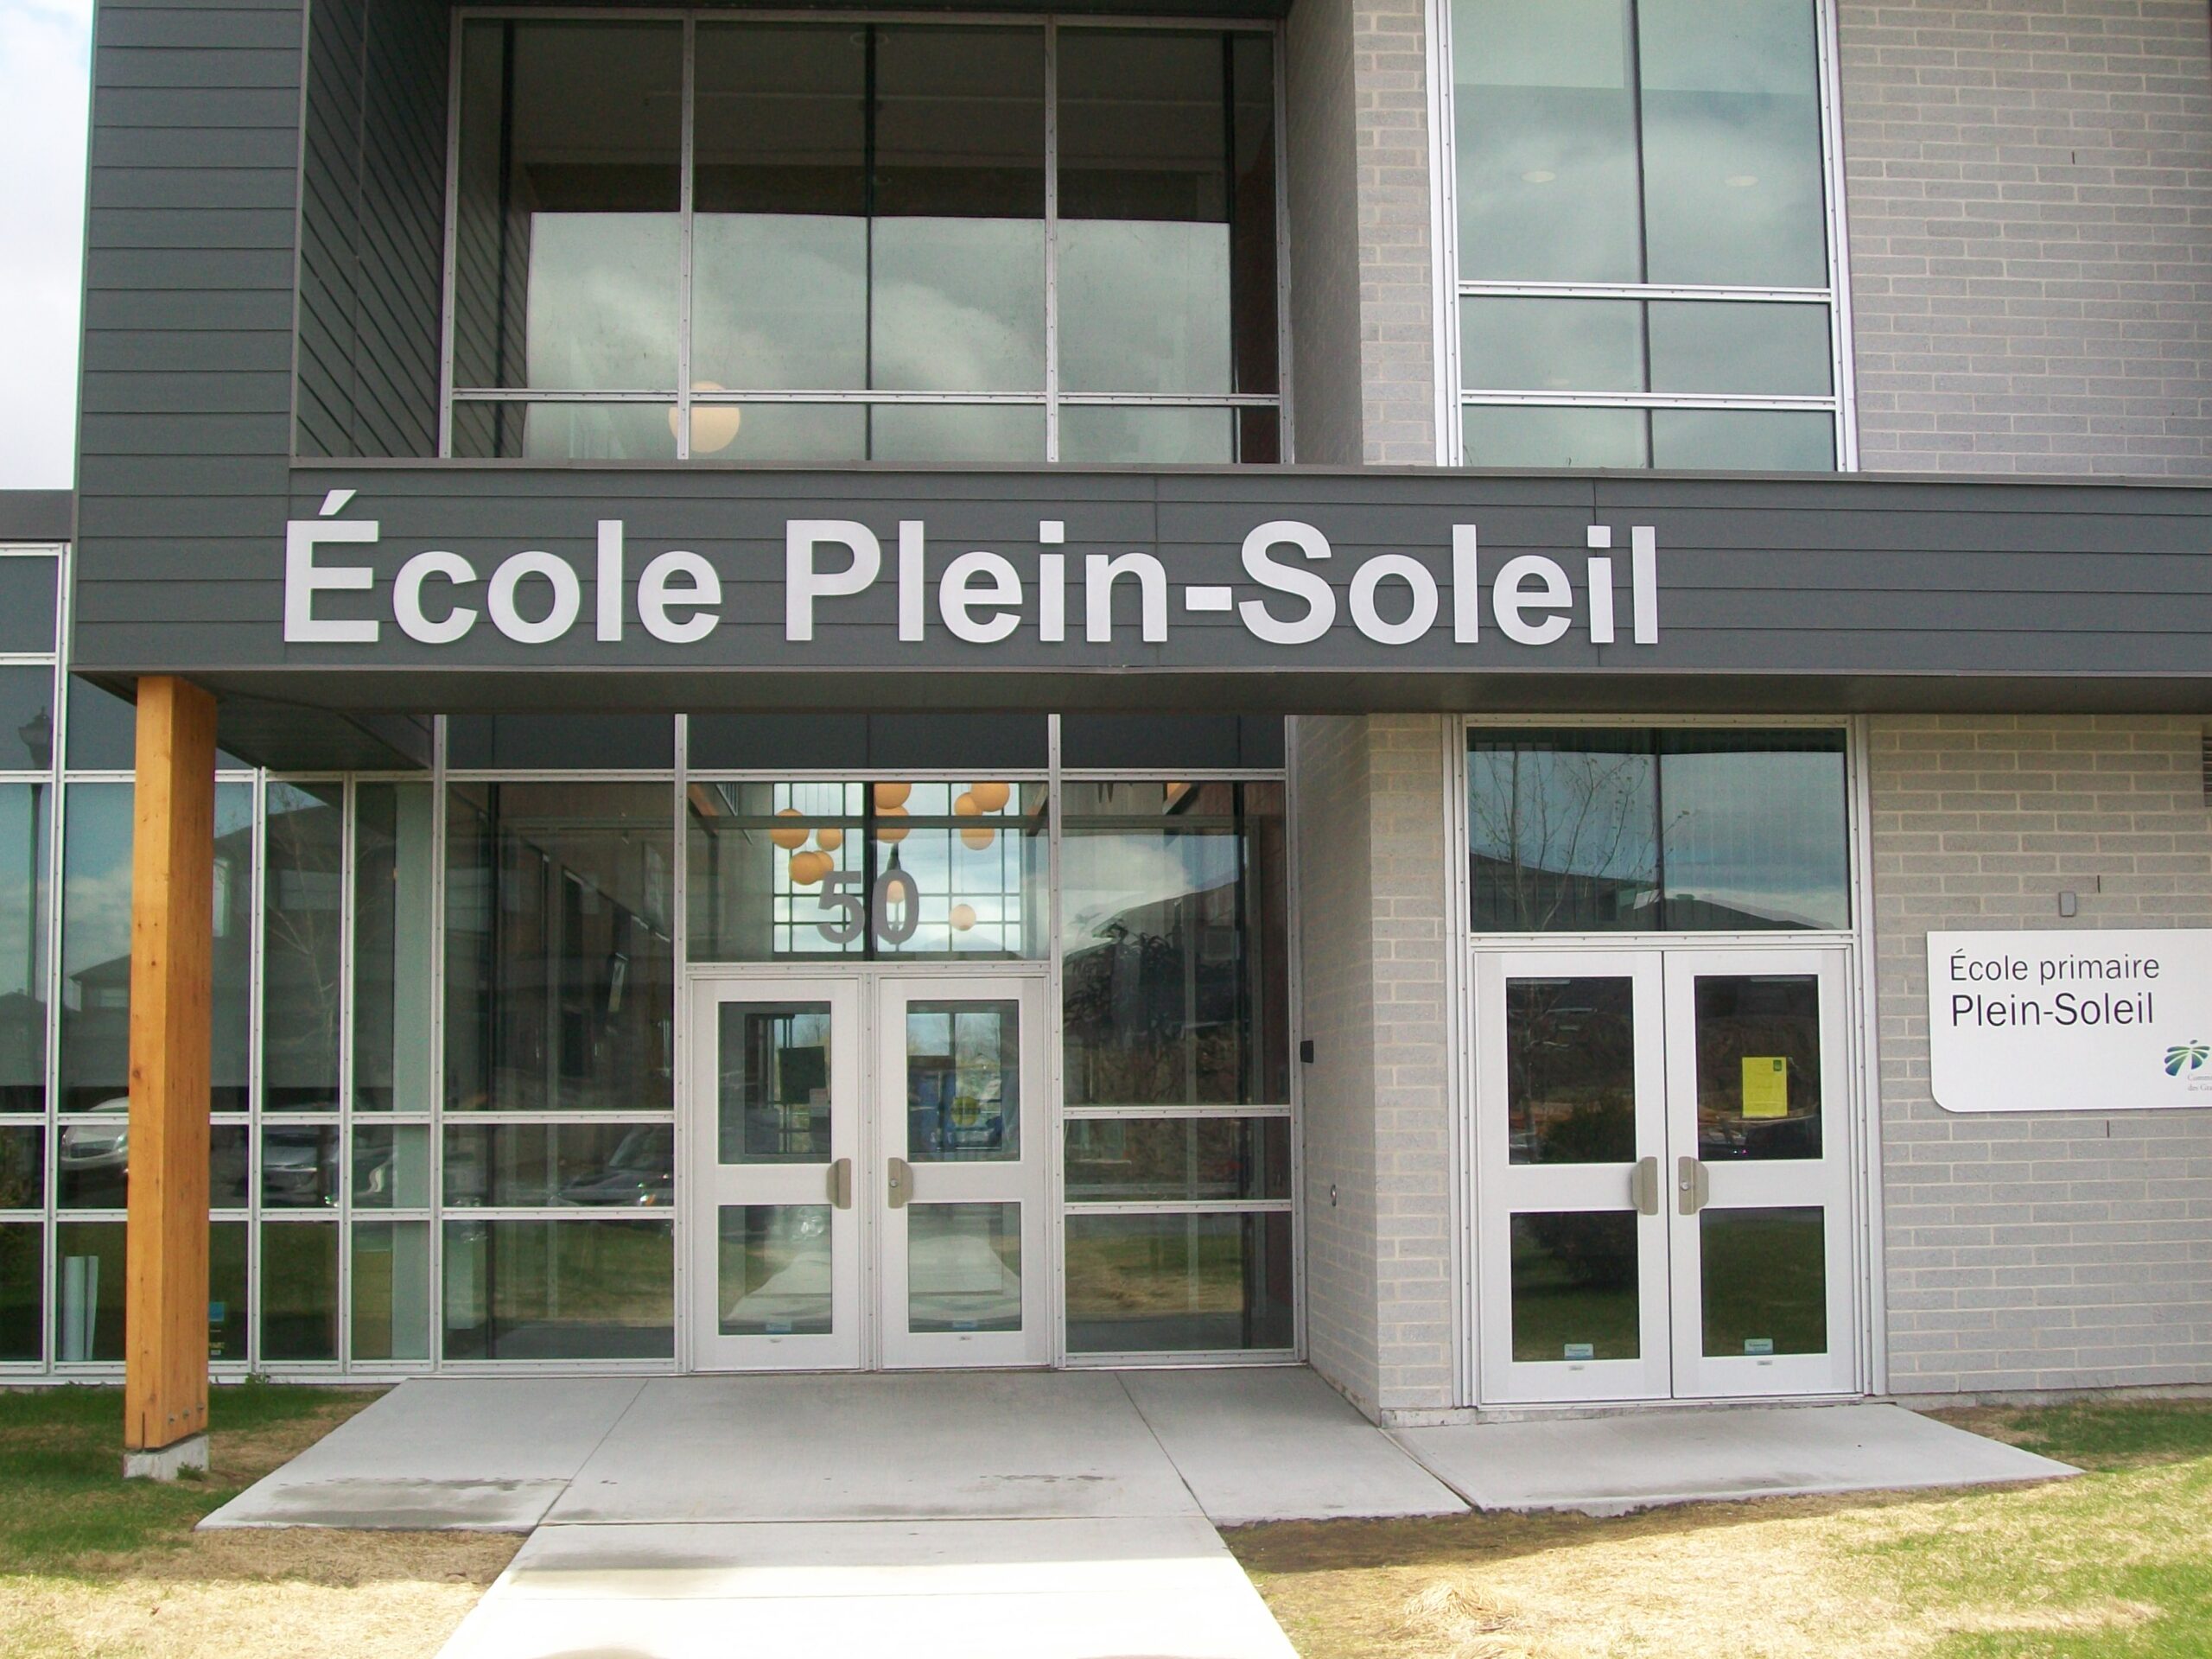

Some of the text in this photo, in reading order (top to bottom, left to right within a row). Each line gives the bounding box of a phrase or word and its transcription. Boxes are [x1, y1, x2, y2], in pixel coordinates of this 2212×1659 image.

[284, 489, 1658, 645] École Plein-Soleil
[817, 869, 919, 944] 50
[1950, 948, 2159, 985] École primaire
[1952, 992, 2153, 1027] Plein-Soleil
